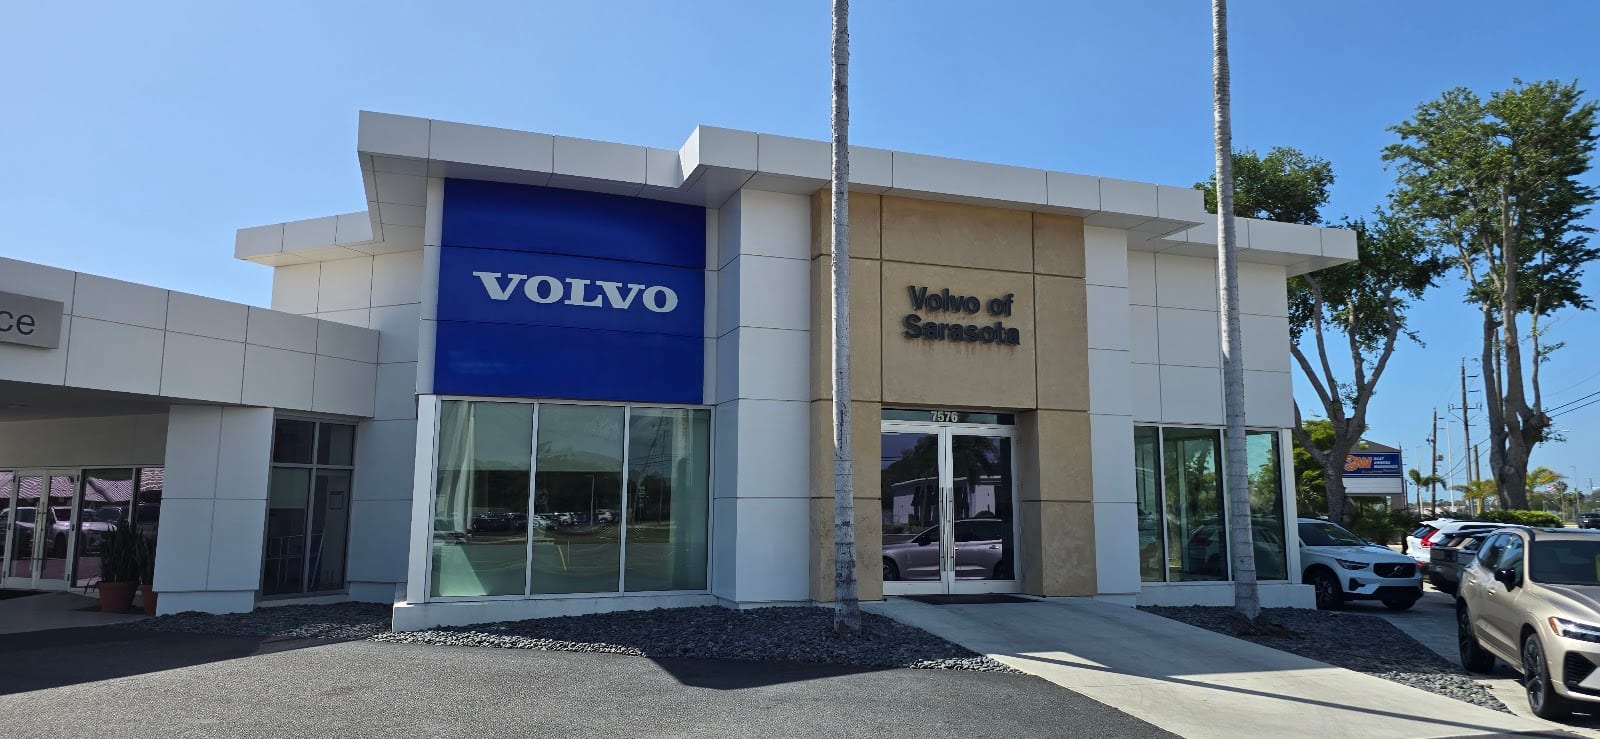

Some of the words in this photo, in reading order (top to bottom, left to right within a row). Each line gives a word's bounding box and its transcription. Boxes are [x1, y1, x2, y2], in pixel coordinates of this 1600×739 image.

[472, 271, 679, 313] VOLVO
[907, 285, 981, 314] Volvo
[987, 293, 1014, 317] of
[901, 313, 1021, 346] Sarasota
[930, 410, 958, 423] 7576
